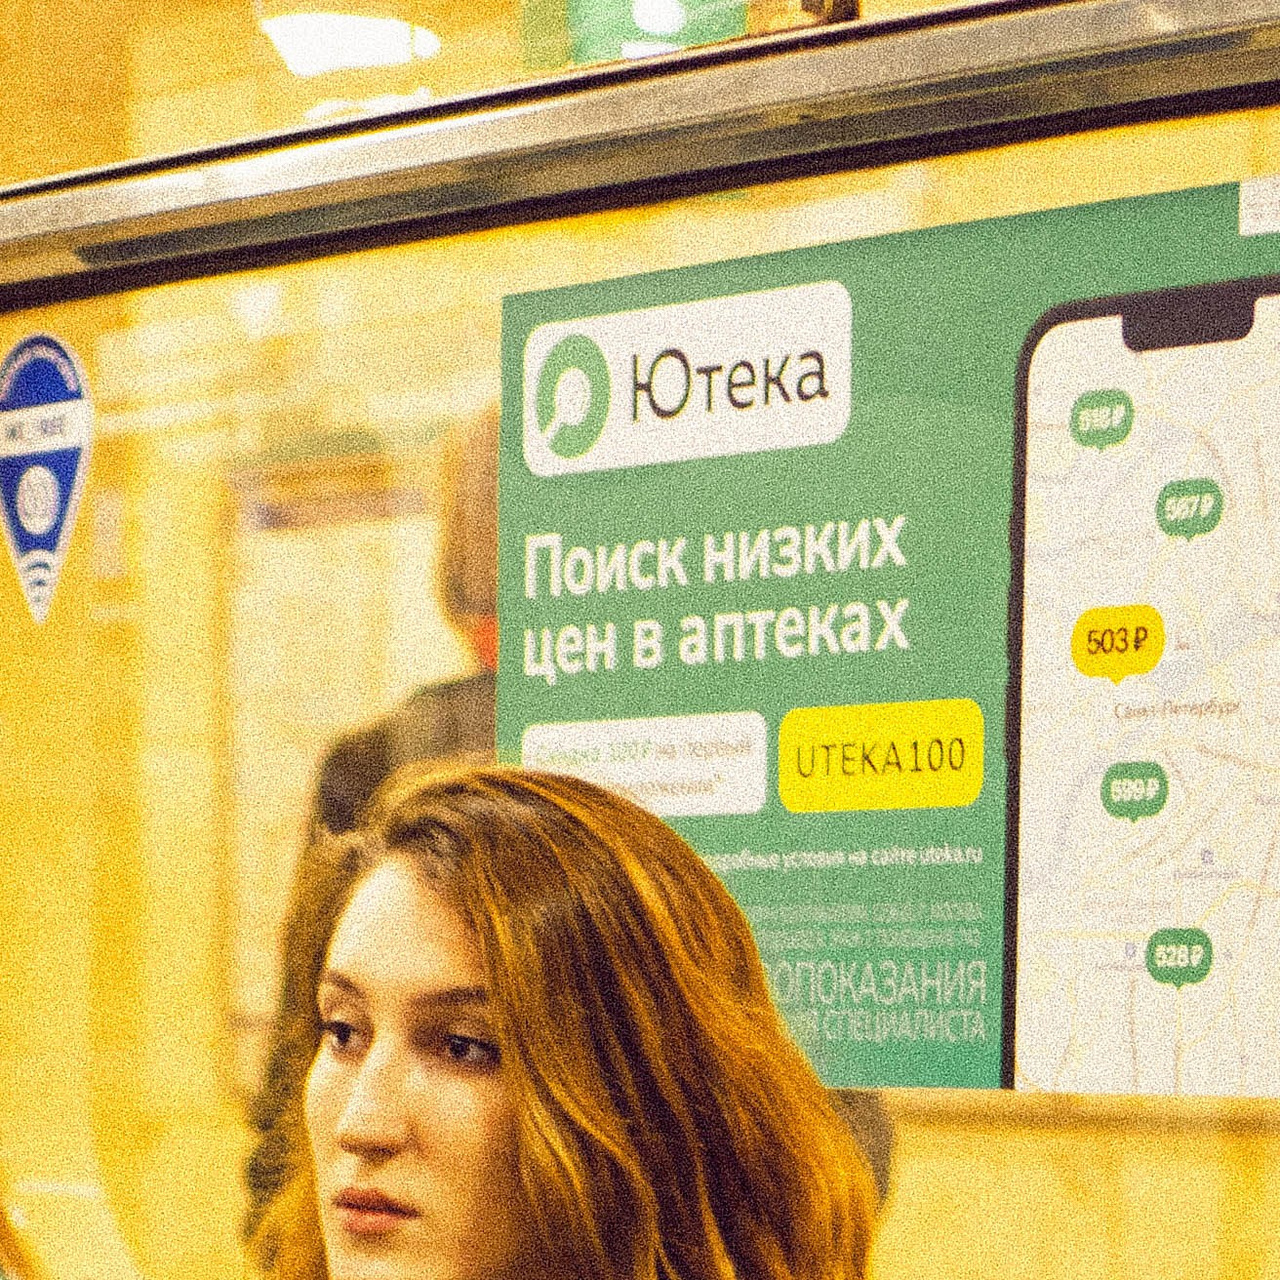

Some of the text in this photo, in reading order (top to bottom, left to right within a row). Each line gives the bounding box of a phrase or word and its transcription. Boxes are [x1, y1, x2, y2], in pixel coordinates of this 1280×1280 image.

[633, 348, 829, 421] Ютека
[524, 516, 907, 600] Поиск низких
[523, 598, 911, 685] цен в аптеках
[795, 738, 967, 779] UTEKA100
[773, 959, 987, 1006] ОПОКАЗАНИЯ
[823, 1009, 987, 1046] СПЕЦИАЛИСТА
